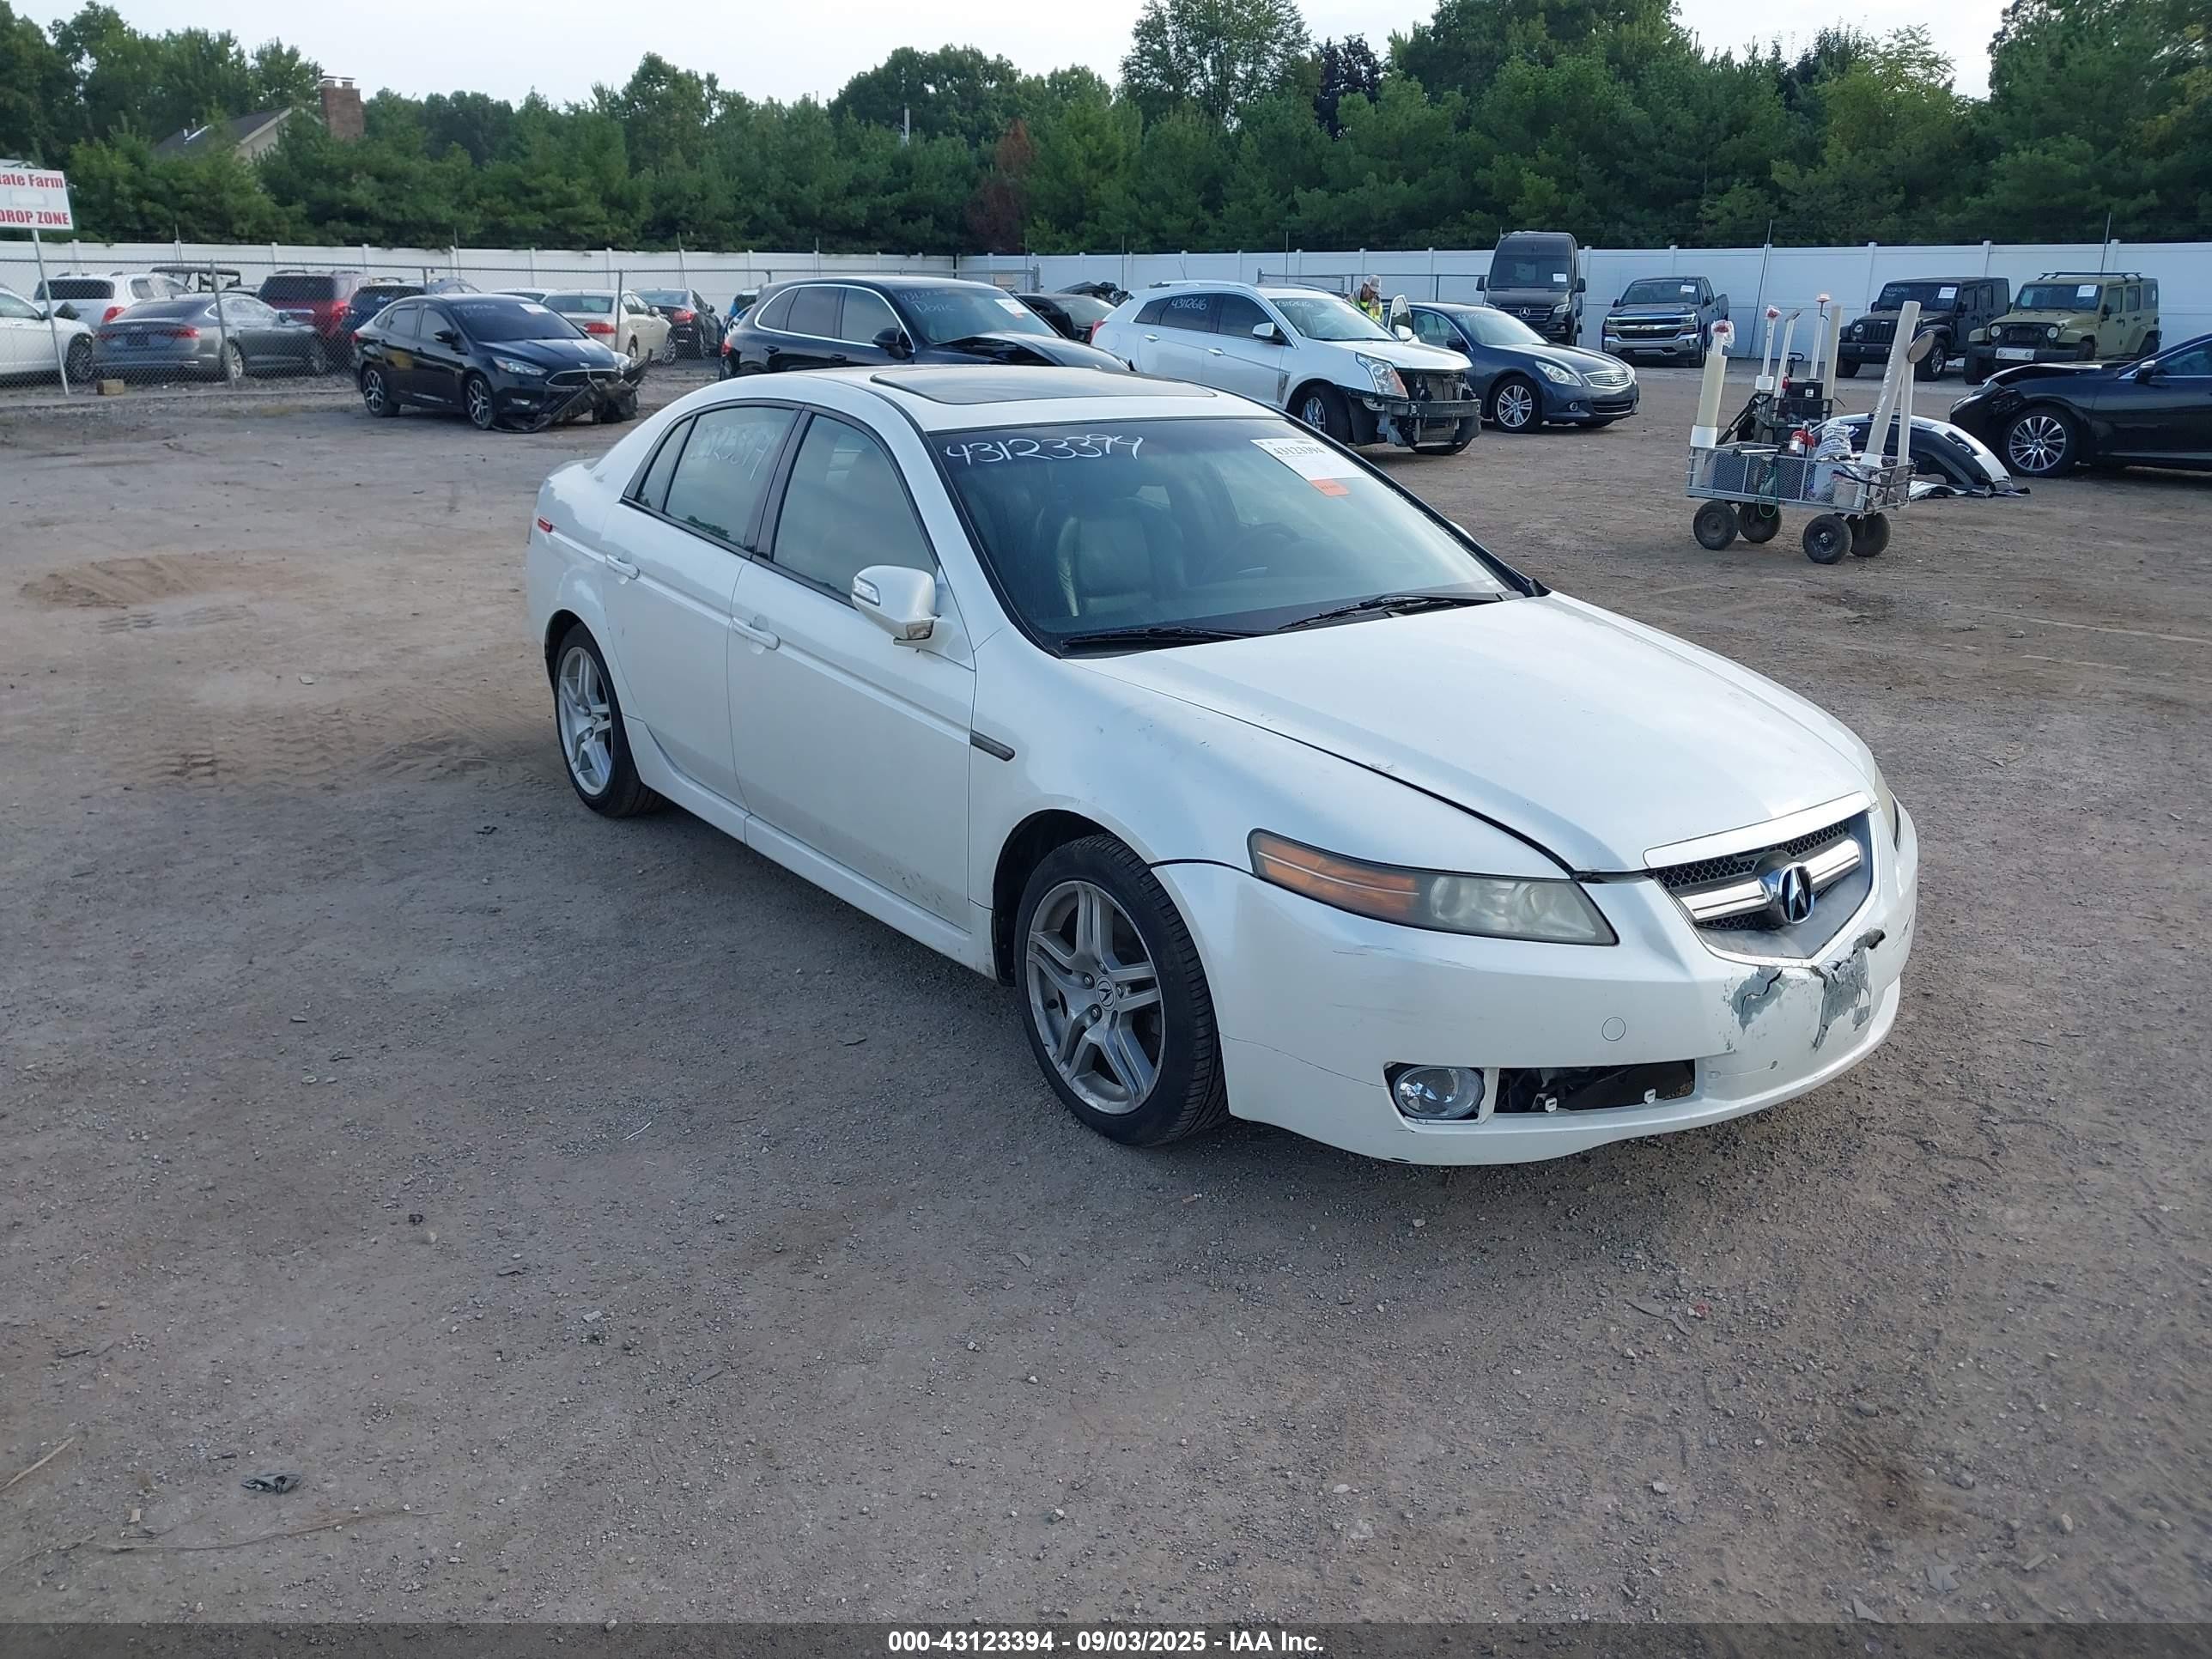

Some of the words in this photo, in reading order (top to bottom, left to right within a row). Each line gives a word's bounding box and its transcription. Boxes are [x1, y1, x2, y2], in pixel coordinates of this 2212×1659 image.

[0, 173, 26, 186] ate
[28, 173, 64, 188] Farm
[36, 211, 70, 225] ZONE
